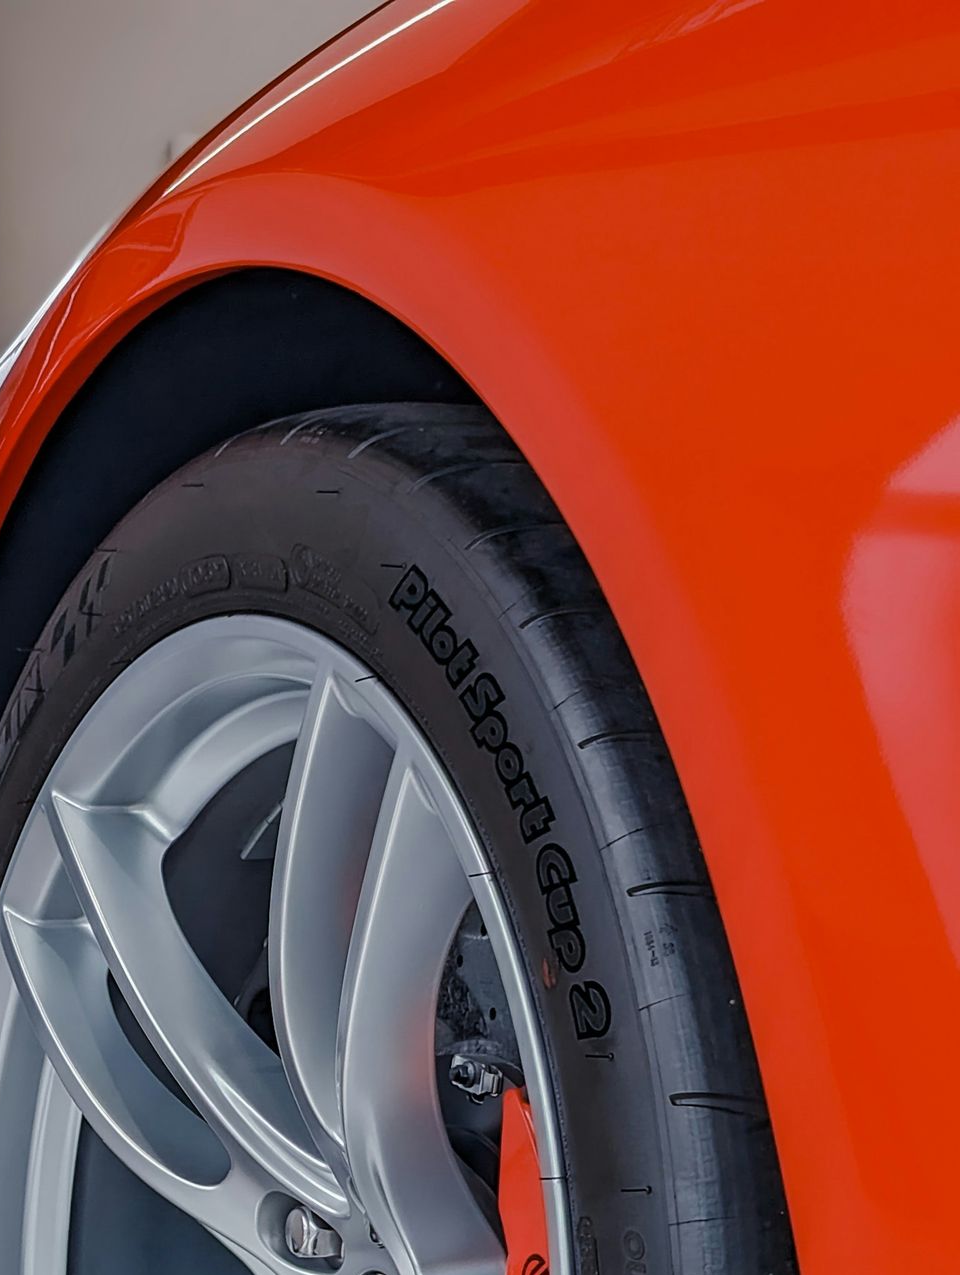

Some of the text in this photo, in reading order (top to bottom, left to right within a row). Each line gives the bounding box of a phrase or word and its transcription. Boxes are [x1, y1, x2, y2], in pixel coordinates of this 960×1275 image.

[388, 564, 612, 1040] Pilot Sport Cup 2
